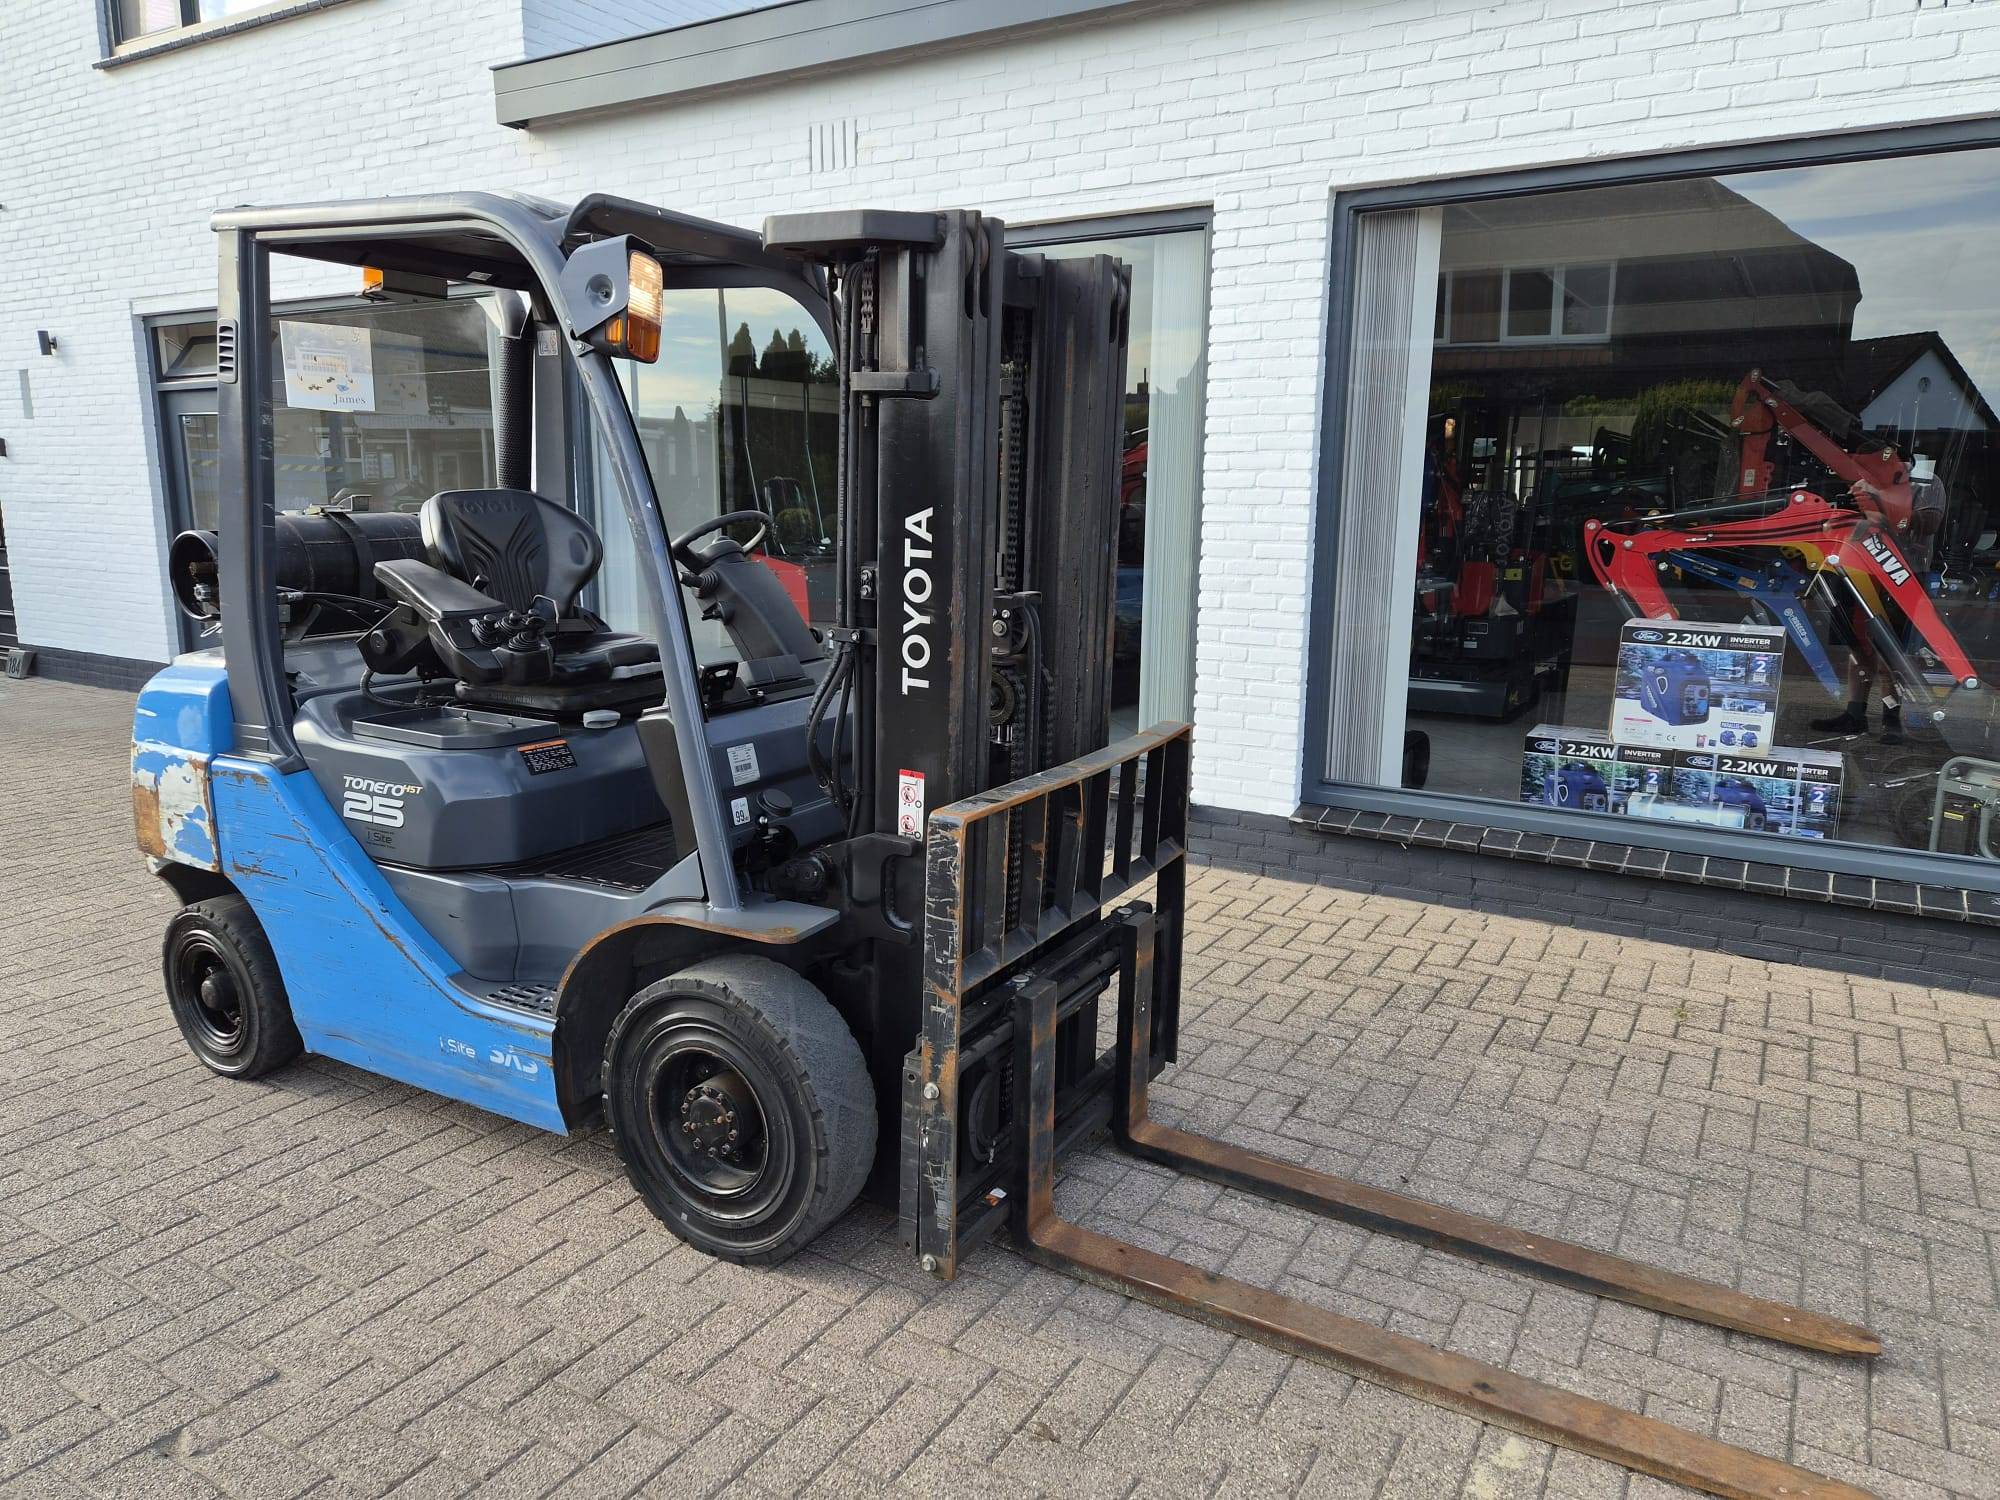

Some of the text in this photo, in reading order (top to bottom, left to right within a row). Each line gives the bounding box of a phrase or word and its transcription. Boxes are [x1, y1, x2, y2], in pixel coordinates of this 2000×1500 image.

[333, 394, 366, 406] James
[901, 506, 934, 696] TOYOTA
[1636, 630, 1721, 647] Ford 2.2KW
[1730, 636, 1771, 645] INVERTER
[1756, 660, 1766, 673] 2
[1566, 743, 1616, 759] 2.2KW
[1624, 749, 1662, 759] INVERTER
[1721, 758, 1778, 776] 2.2KW
[1786, 765, 1829, 776] INERTER
[1648, 772, 1658, 784] 2
[1814, 790, 1824, 803] 2
[343, 790, 405, 829] 25
[735, 810, 745, 822] 99
[447, 1038, 476, 1059] Site
